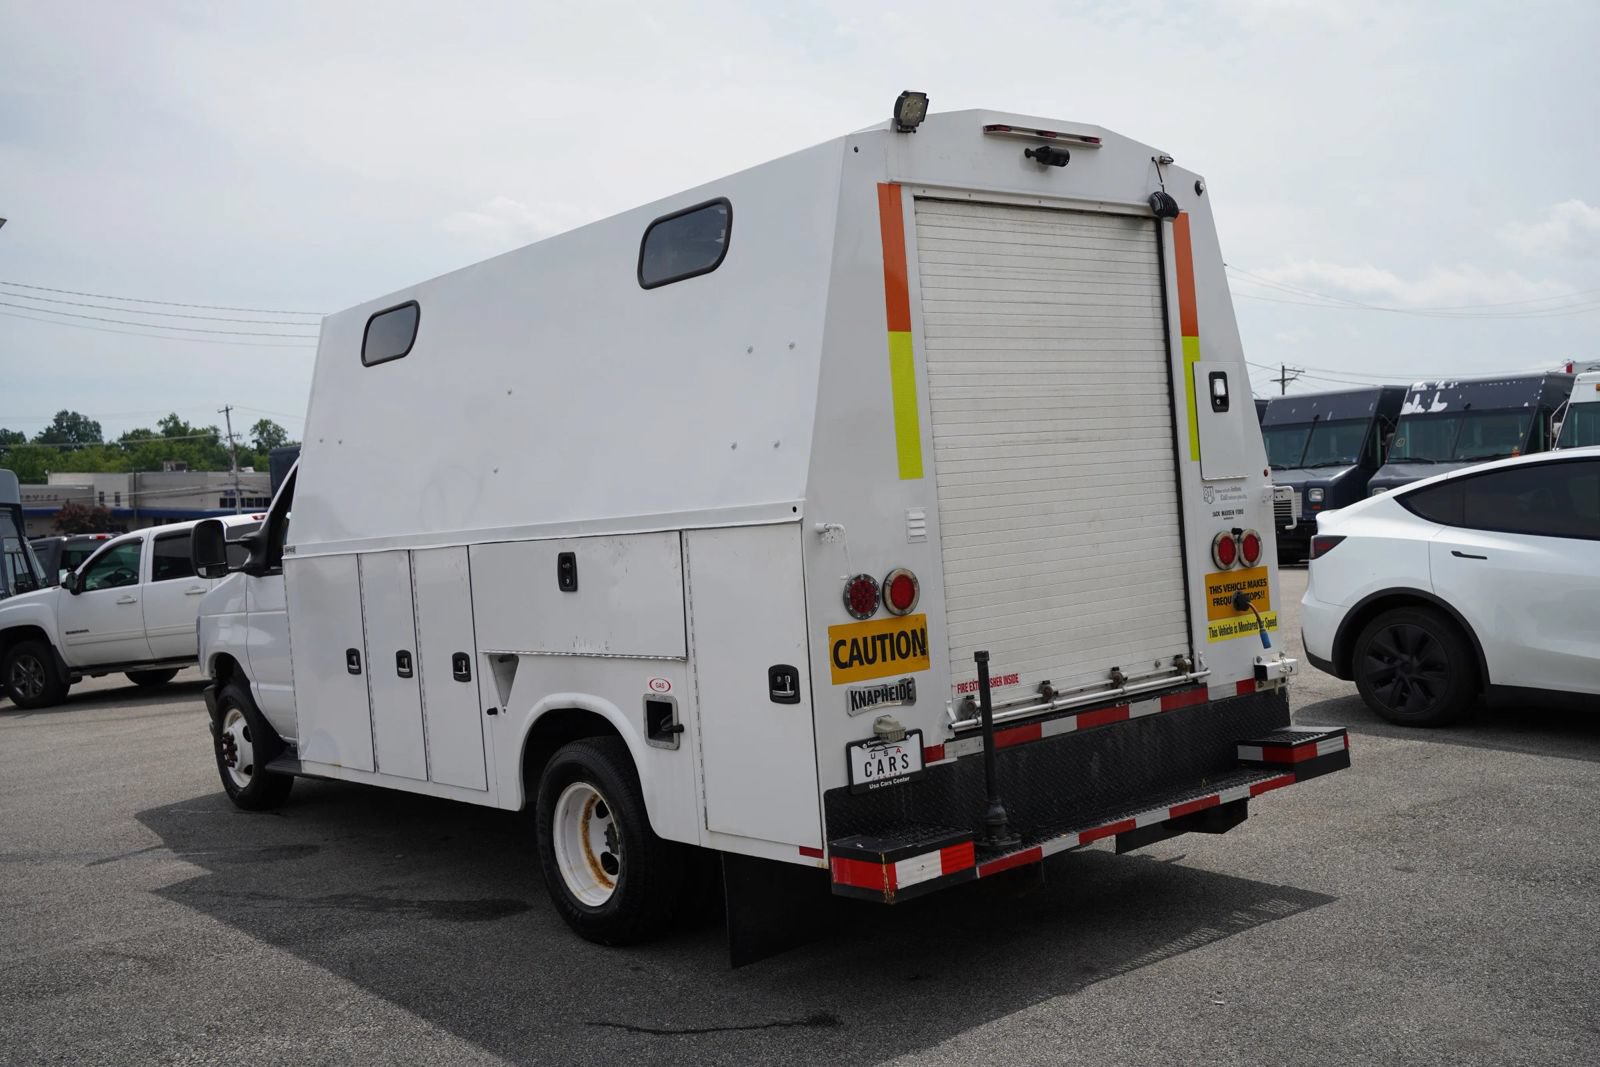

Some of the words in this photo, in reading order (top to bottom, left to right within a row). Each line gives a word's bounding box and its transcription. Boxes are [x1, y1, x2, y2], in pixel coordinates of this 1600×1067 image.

[1209, 584, 1222, 594] THIS
[1223, 581, 1246, 592] VEHICLE
[1247, 578, 1267, 589] MAKES
[1212, 595, 1232, 606] FREQU
[1208, 625, 1218, 639] This
[1218, 624, 1233, 637] Vehicle
[1234, 622, 1237, 634] is
[1265, 616, 1277, 630] Speed
[833, 628, 926, 669] CAUTION
[957, 682, 968, 694] FIRE
[1003, 673, 1020, 685] INSIDE
[850, 681, 914, 711] KNAPHEIDE
[864, 753, 909, 777] CARS
[893, 776, 910, 784] Center
